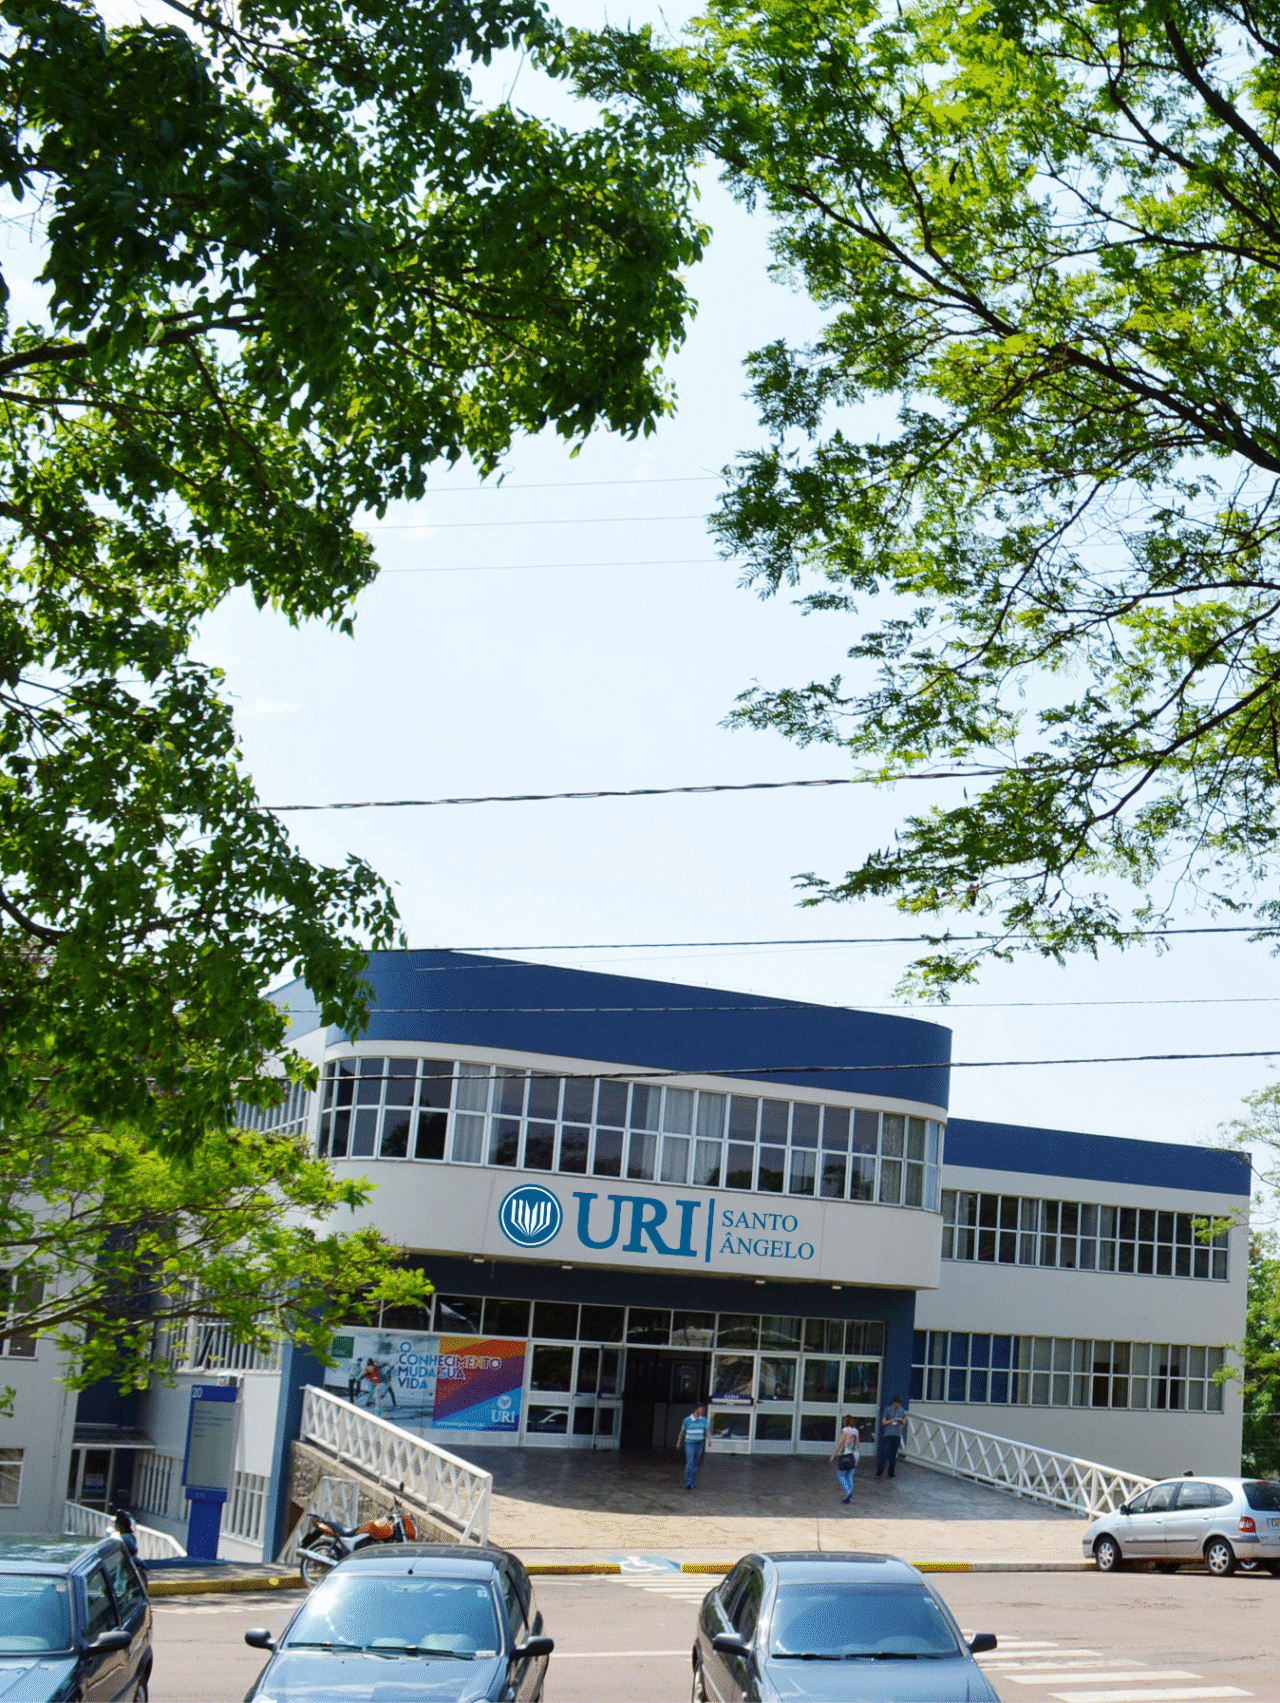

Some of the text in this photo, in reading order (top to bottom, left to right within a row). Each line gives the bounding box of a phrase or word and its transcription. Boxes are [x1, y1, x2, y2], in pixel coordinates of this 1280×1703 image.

[573, 1191, 702, 1258] URI
[722, 1210, 798, 1233] SANTO
[719, 1231, 815, 1261] ÂNGELO
[400, 1341, 412, 1353] O
[398, 1354, 501, 1369] CONHECIMENTO
[398, 1366, 466, 1379] MUDA SUA
[398, 1377, 428, 1389] VIDA
[491, 1410, 516, 1423] URI
